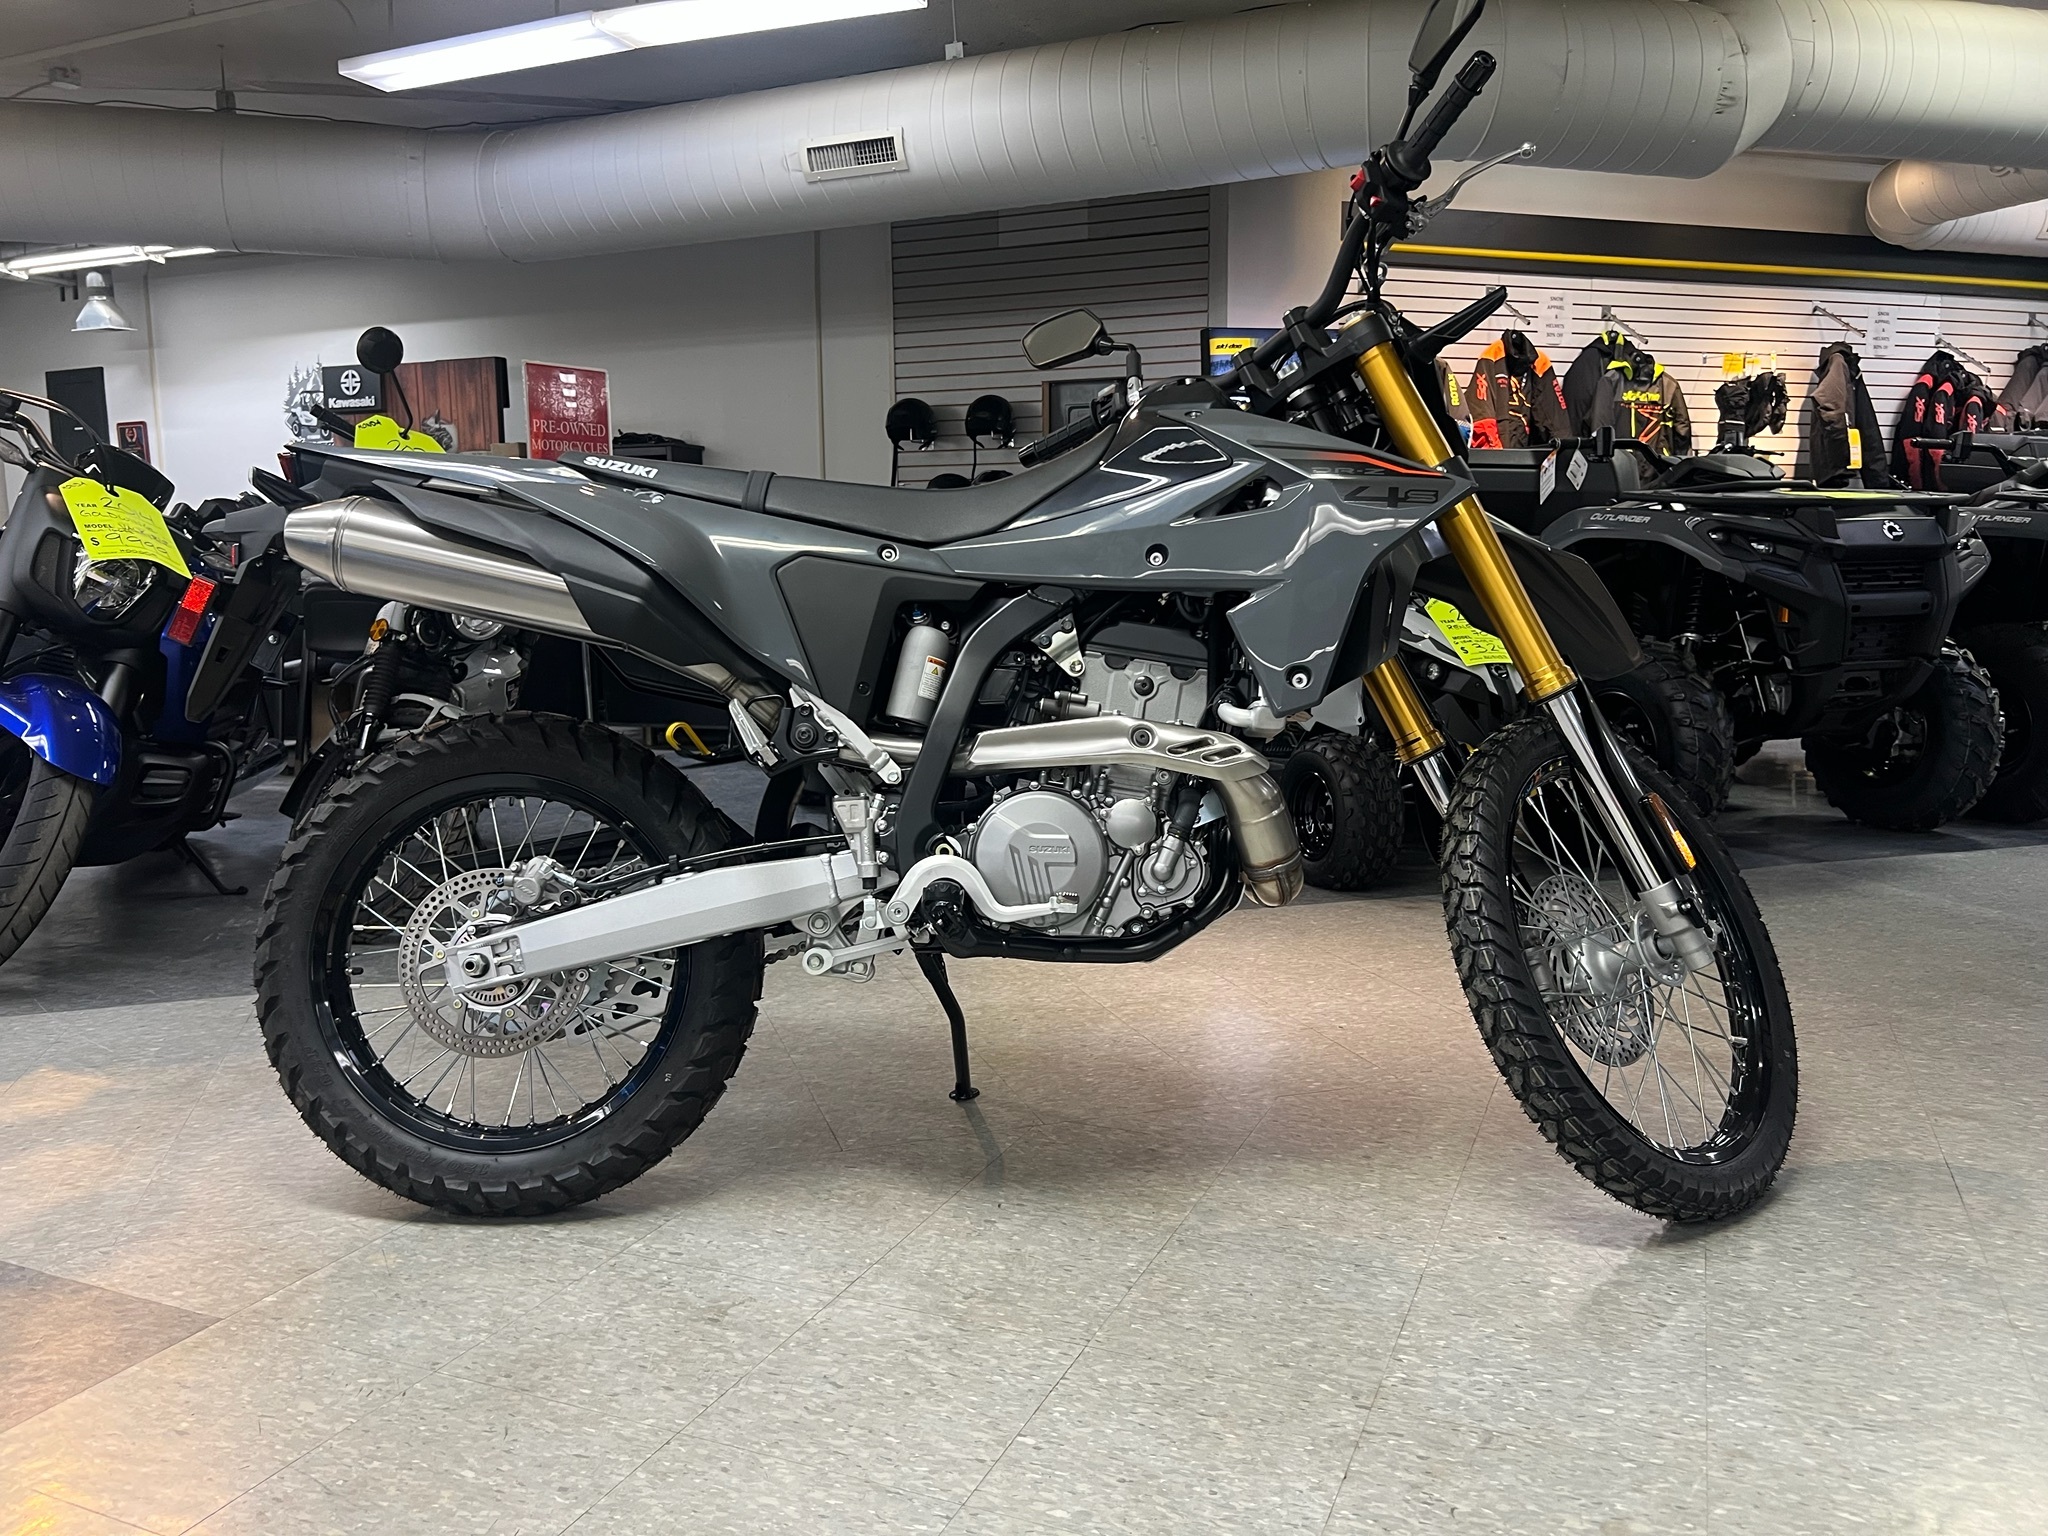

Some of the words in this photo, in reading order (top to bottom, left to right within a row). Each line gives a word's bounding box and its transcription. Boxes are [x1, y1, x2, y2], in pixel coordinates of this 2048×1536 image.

[1448, 373, 1460, 406] ROTAX
[328, 395, 375, 409] Kawasaki
[358, 419, 382, 430] HONDA
[532, 419, 606, 438] PRE-OWNED
[531, 438, 608, 454] MOTORCYCLES
[583, 456, 659, 479] SUZUKI
[1311, 466, 1385, 475] DR-Z
[1590, 512, 1651, 524] OUTLANDER
[90, 537, 100, 547] $
[1029, 845, 1070, 854] SUZUKI
